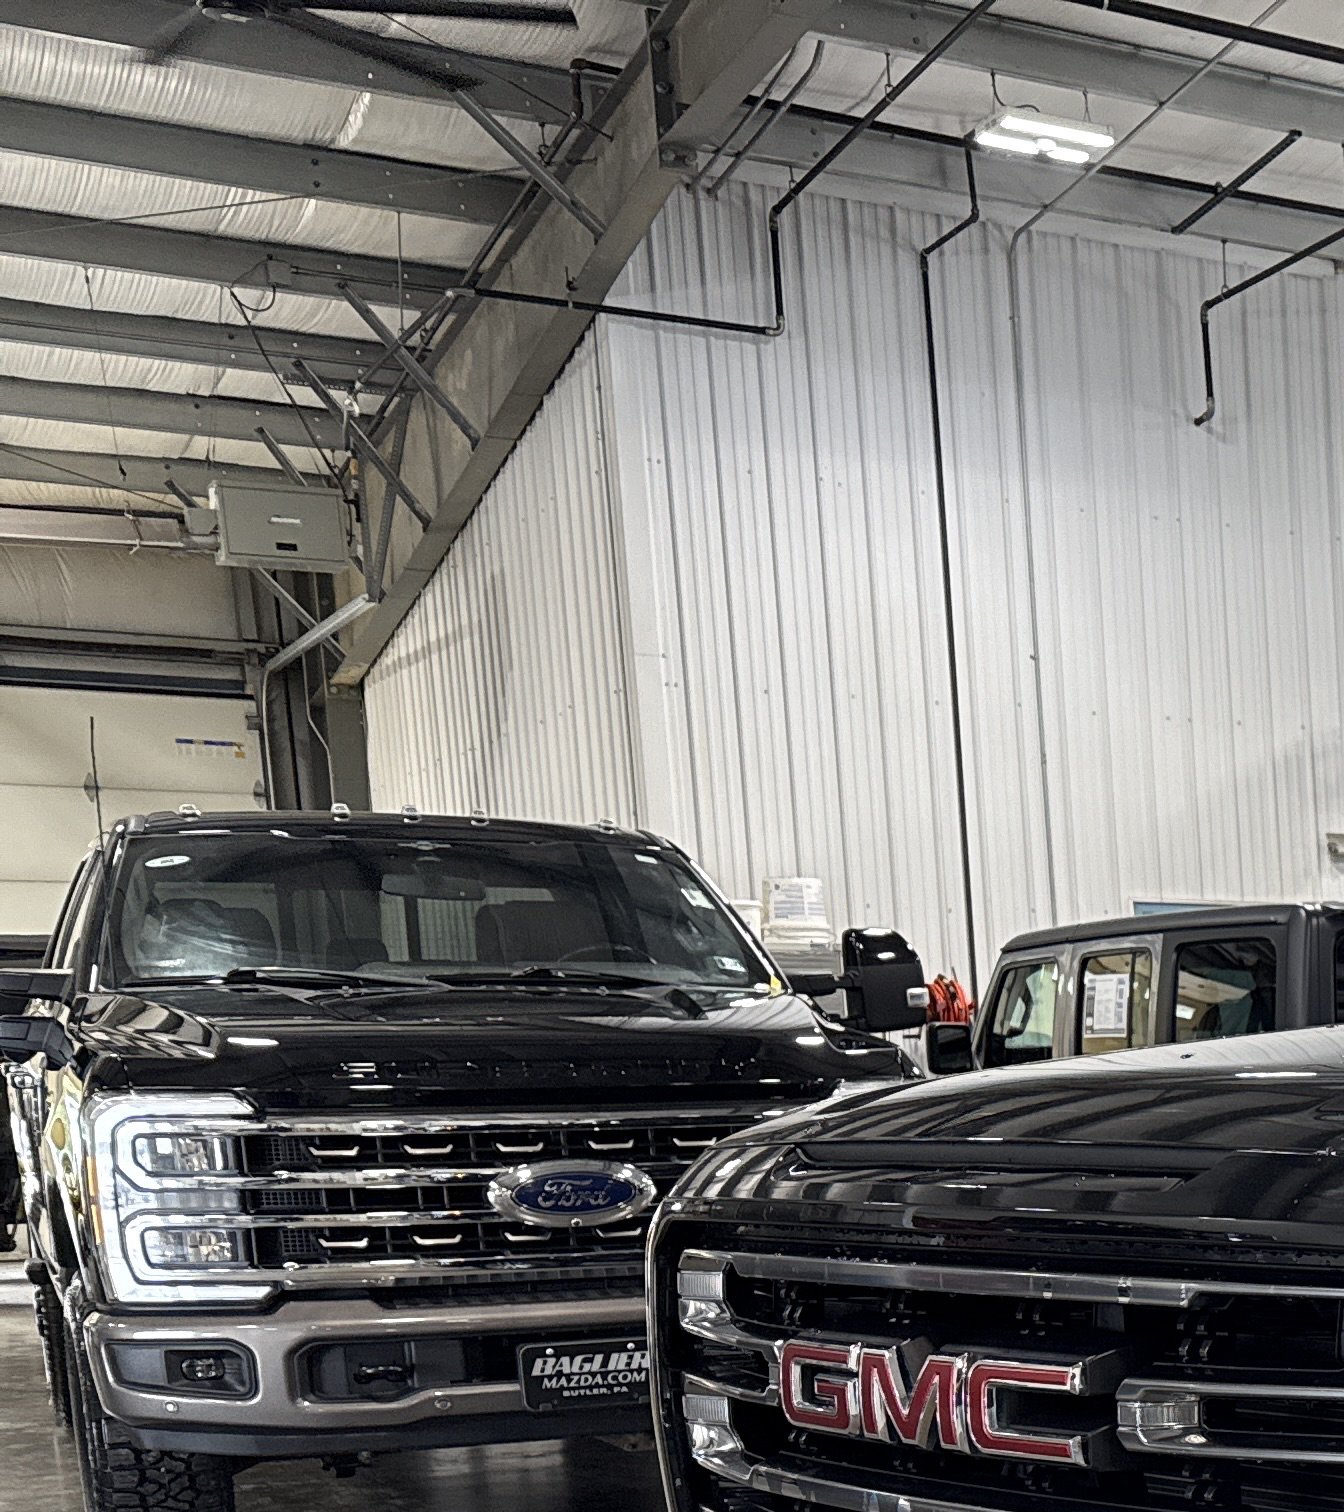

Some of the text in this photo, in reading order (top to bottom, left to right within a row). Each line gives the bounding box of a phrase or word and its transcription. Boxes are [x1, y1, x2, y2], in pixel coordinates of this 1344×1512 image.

[537, 1178, 611, 1208] Ford
[531, 1351, 650, 1377] BAGLIER
[542, 1370, 647, 1390] MAZDA.COM
[562, 1385, 629, 1398] BUTLER, PA
[779, 1338, 1088, 1467] GMC
